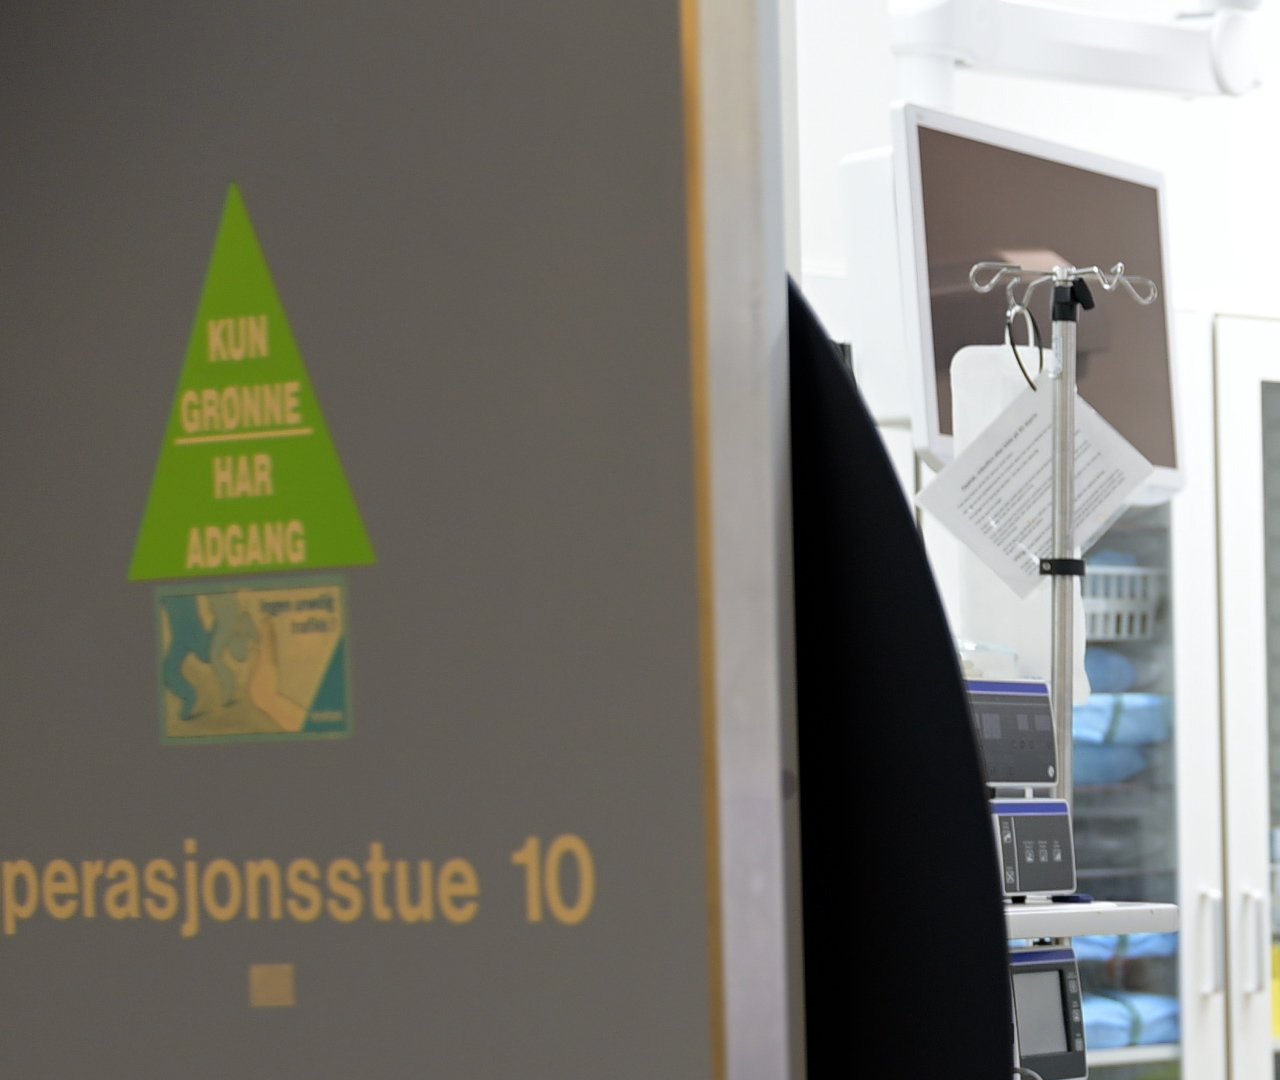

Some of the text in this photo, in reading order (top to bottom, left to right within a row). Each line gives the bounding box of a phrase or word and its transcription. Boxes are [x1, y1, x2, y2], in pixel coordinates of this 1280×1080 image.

[207, 316, 269, 362] KUN
[180, 382, 303, 434] GRØNNE
[214, 455, 273, 498] HAR
[186, 521, 306, 570] ADGANG
[1, 833, 596, 937] perasjonsstue 10
